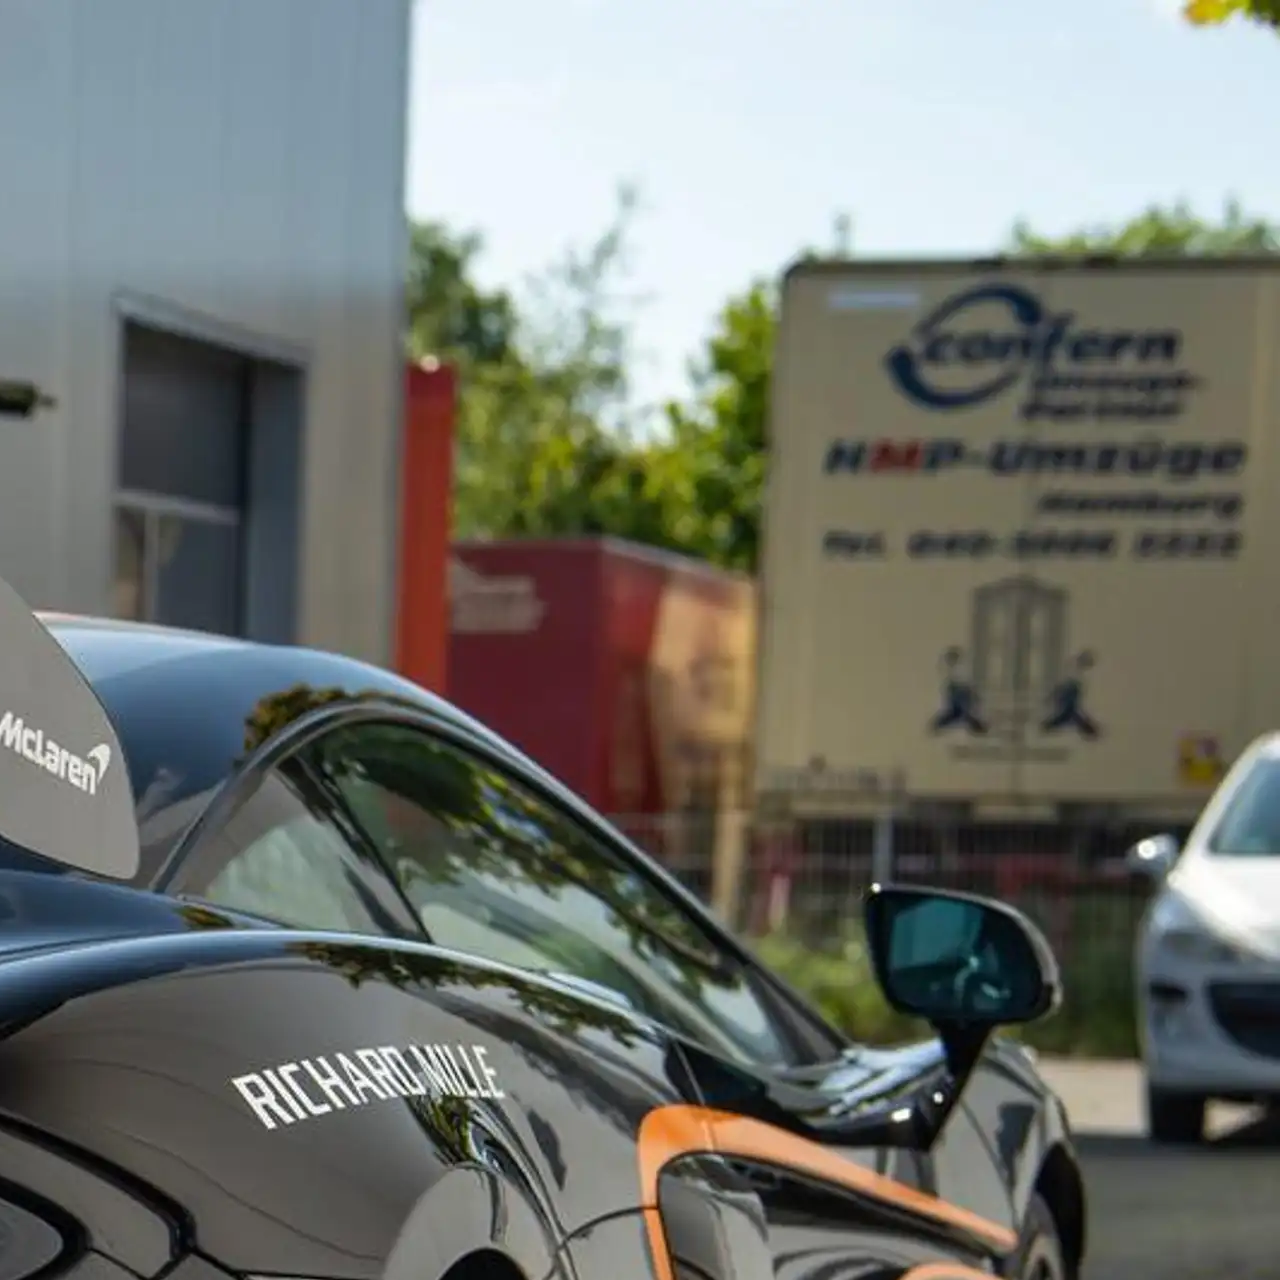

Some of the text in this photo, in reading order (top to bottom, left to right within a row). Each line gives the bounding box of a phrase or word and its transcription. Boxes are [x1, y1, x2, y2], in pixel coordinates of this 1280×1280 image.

[824, 434, 1248, 482] HMP-Umzüge
[231, 1043, 506, 1130] RICHARD MILLE
